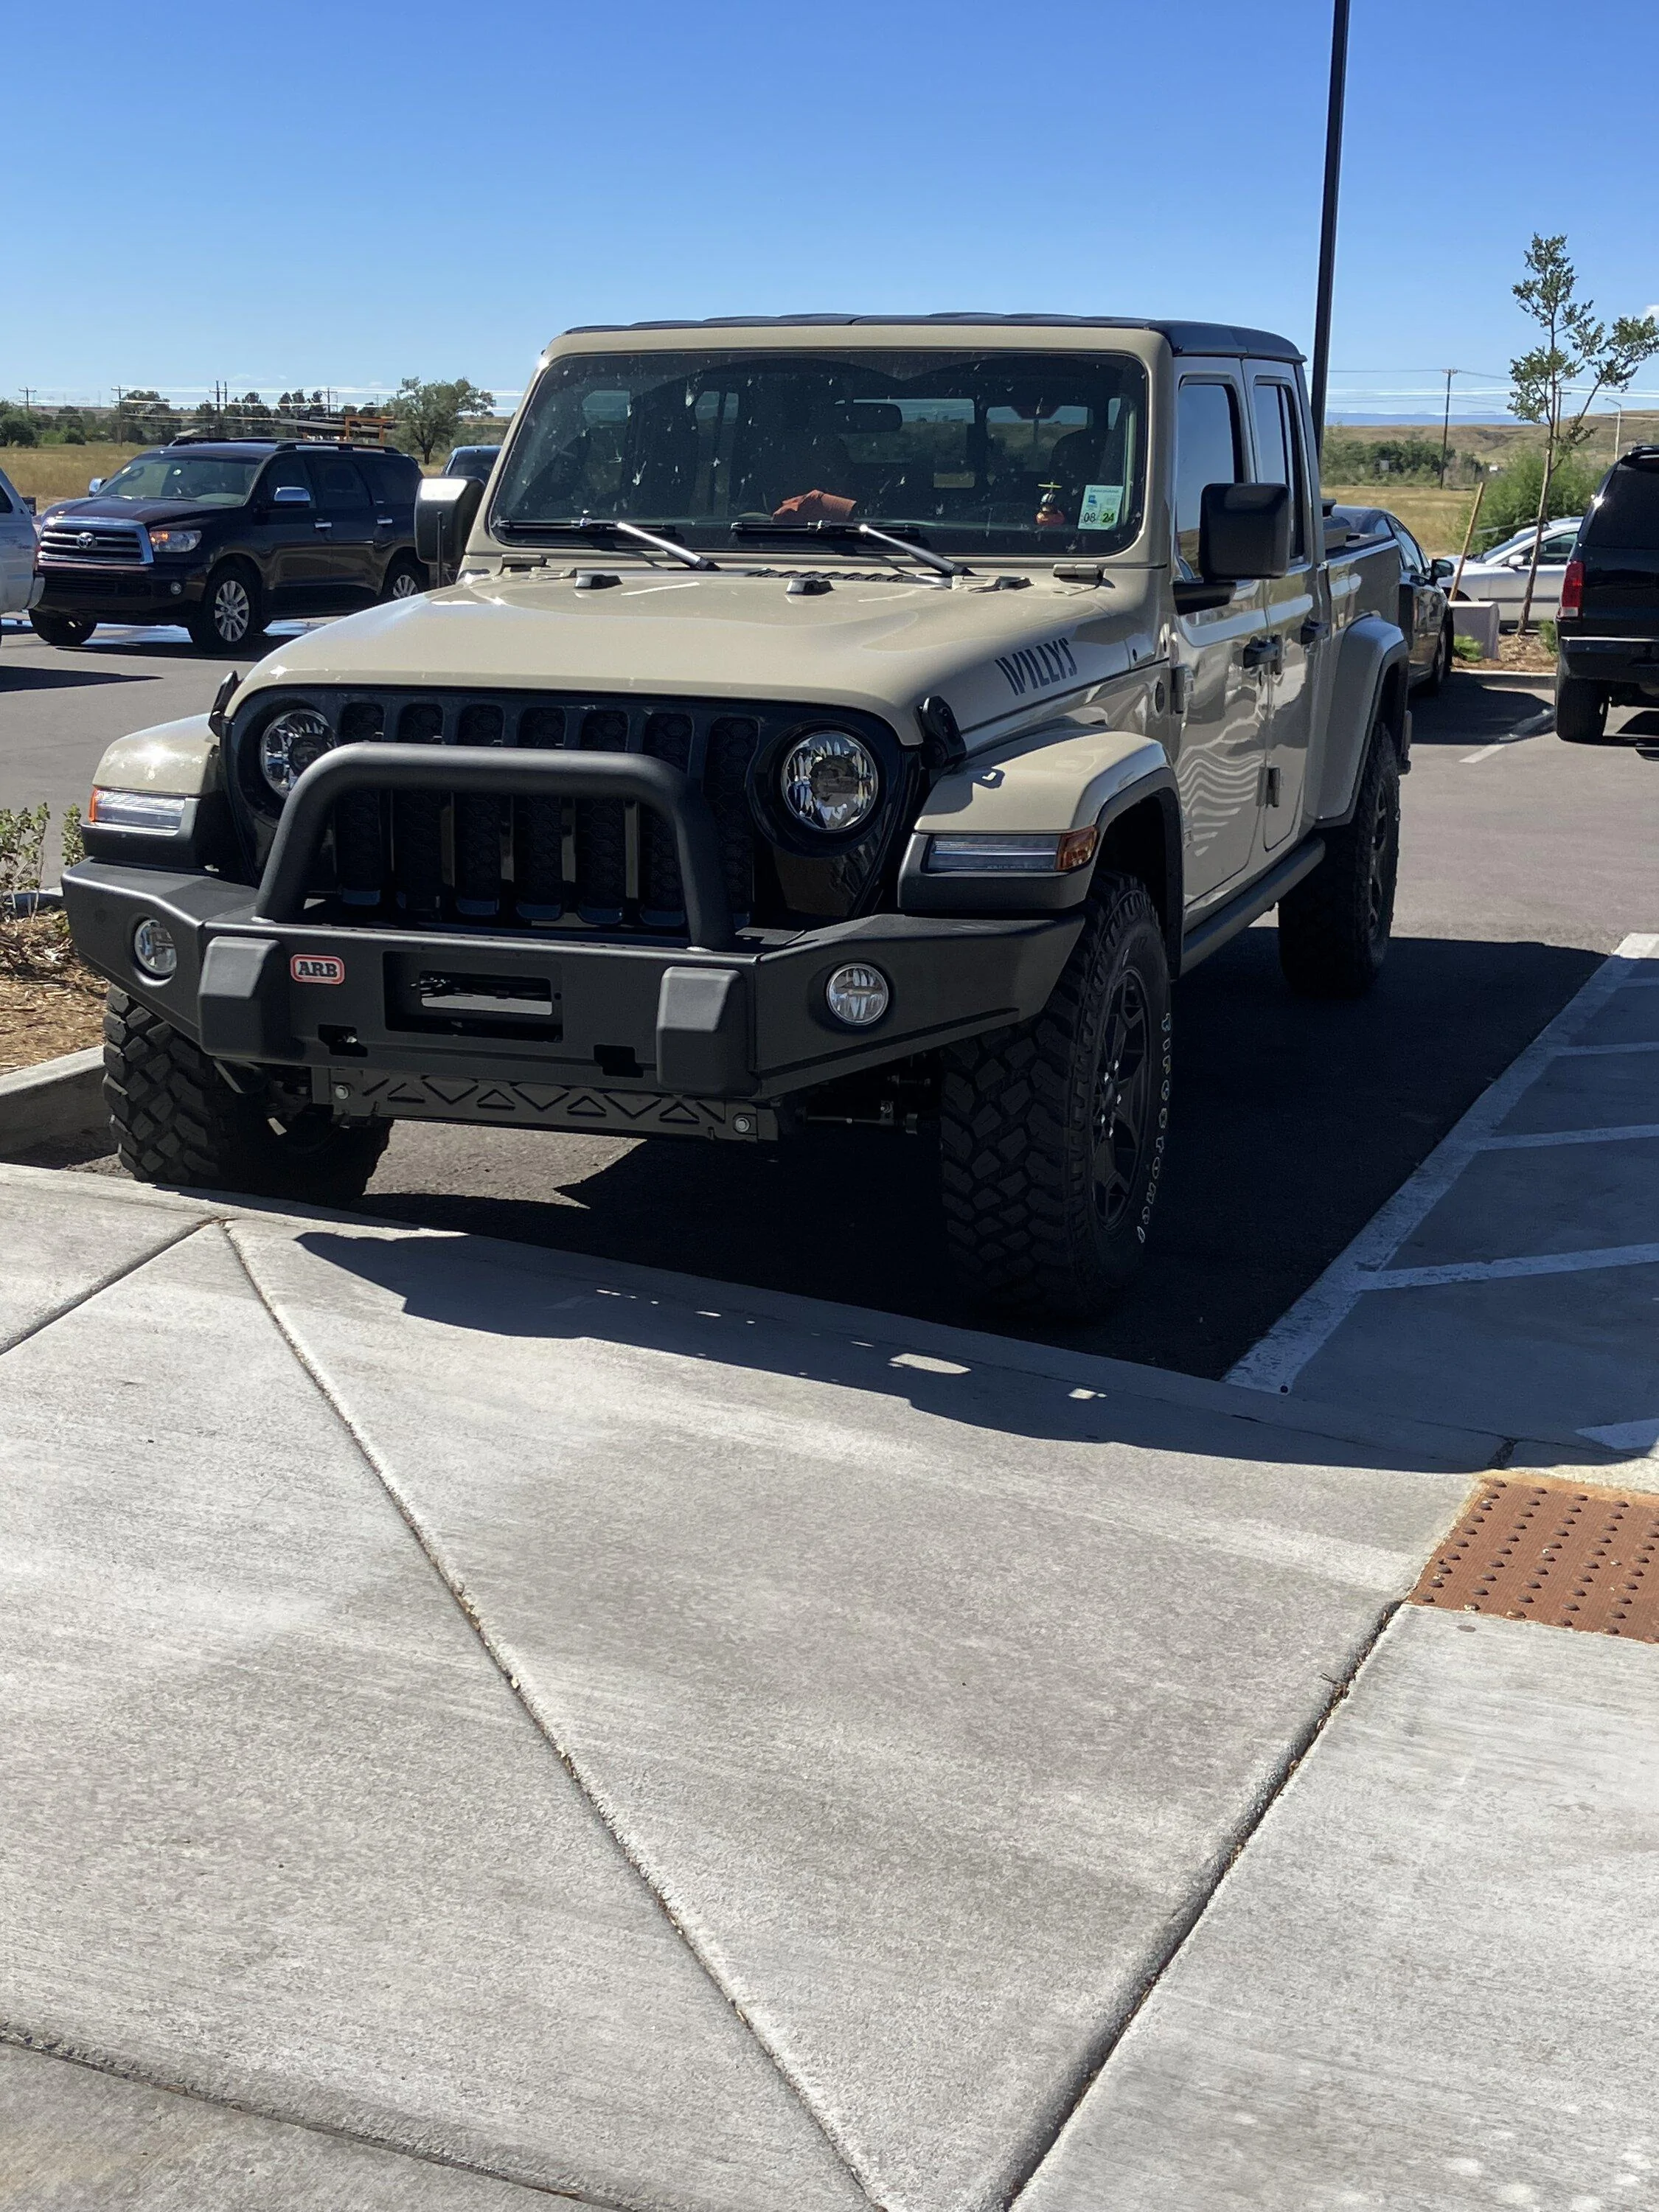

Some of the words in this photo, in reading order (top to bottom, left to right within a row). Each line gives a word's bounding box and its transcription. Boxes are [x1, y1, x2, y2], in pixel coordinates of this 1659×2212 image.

[1084, 512, 1096, 523] 08
[1102, 512, 1115, 523] 24
[995, 637, 1077, 695] WILLYS
[298, 961, 338, 978] ARB
